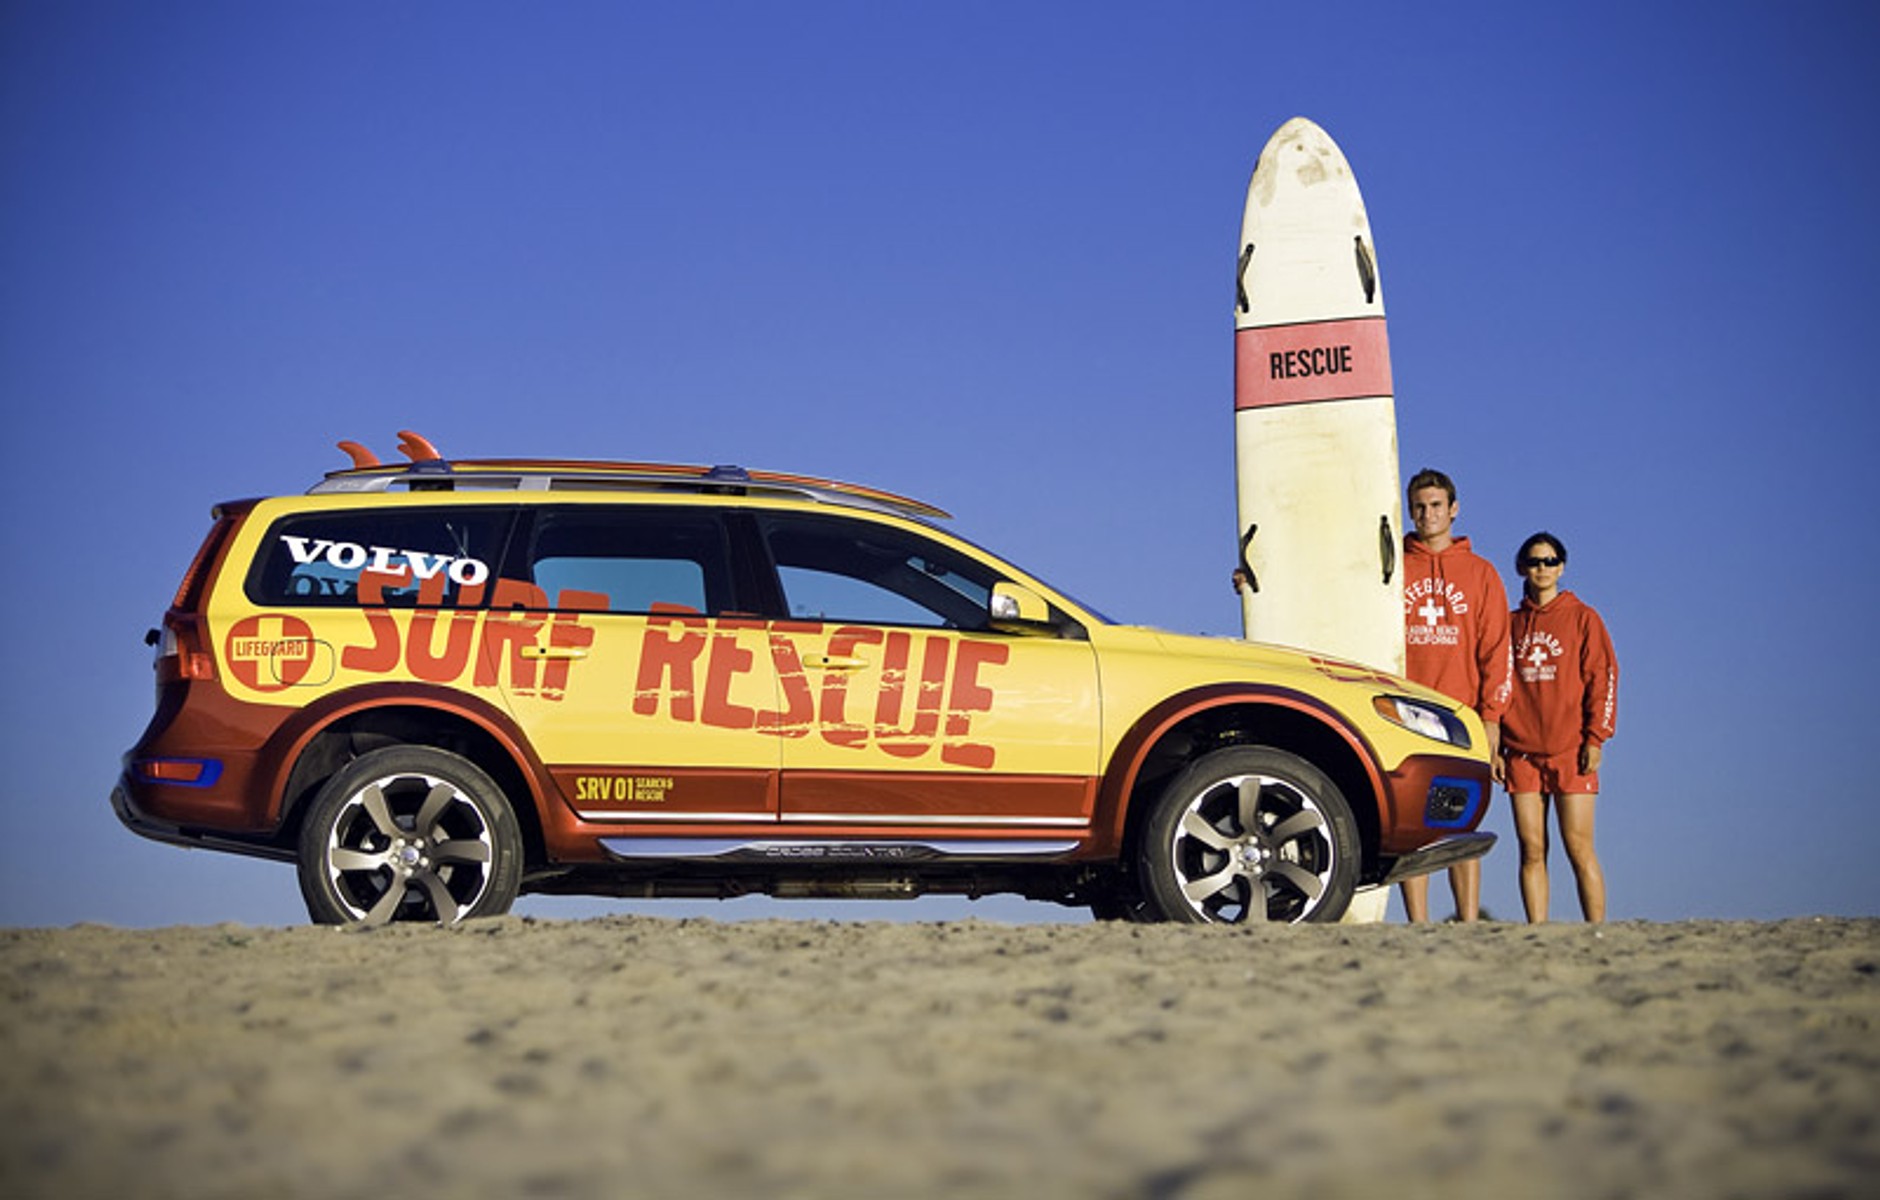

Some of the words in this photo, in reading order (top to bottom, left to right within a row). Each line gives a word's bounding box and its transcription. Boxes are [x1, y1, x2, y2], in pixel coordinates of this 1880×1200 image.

[1269, 345, 1353, 379] RESCUE
[280, 535, 489, 586] VOLVO
[236, 641, 304, 656] LIFEGUARD
[341, 565, 610, 701] SURF
[632, 601, 1010, 770] RESCUE
[576, 777, 612, 800] SRV
[615, 777, 633, 800] 01
